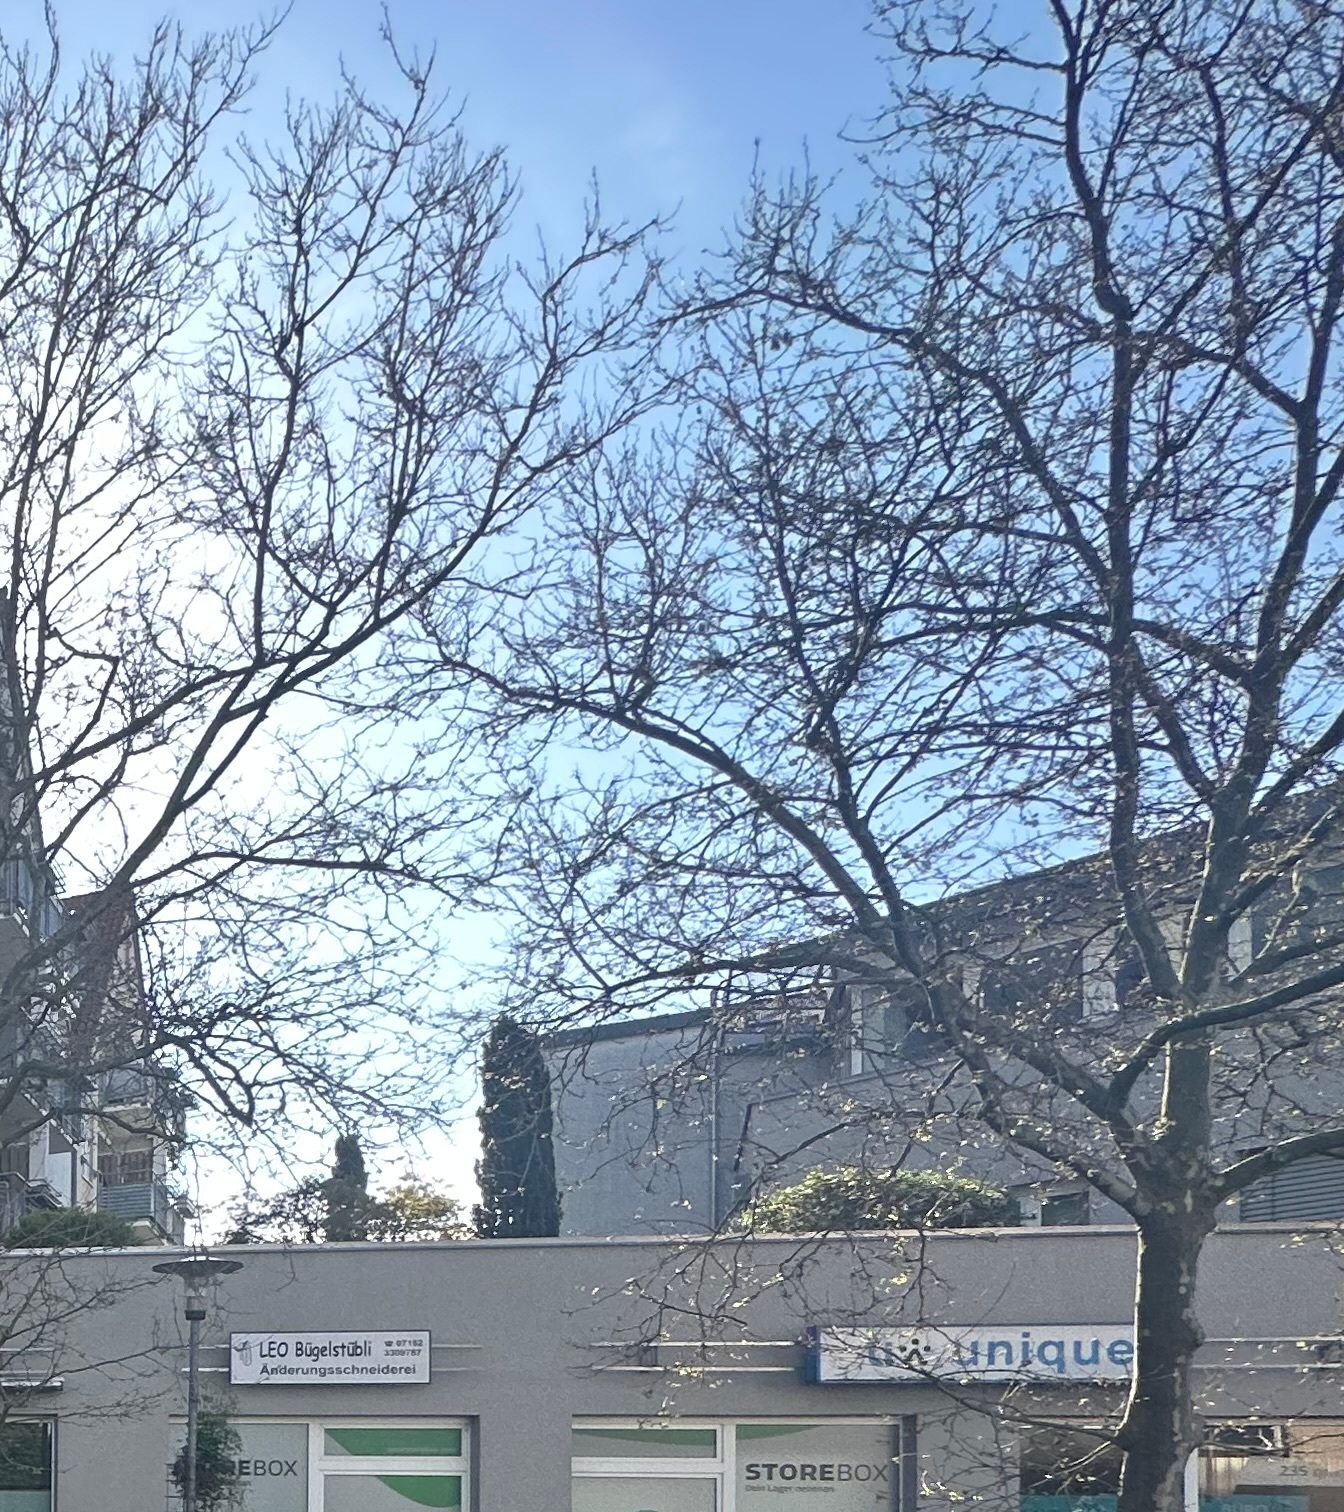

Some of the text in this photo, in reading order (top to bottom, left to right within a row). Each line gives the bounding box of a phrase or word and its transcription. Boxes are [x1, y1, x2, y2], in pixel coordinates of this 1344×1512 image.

[259, 1340, 289, 1358] LEO
[295, 1340, 372, 1362] Bügelstübli
[957, 1331, 1134, 1375] unique
[259, 1363, 416, 1377] Änderungsschneiderei
[745, 1463, 888, 1482] STOREBOX
